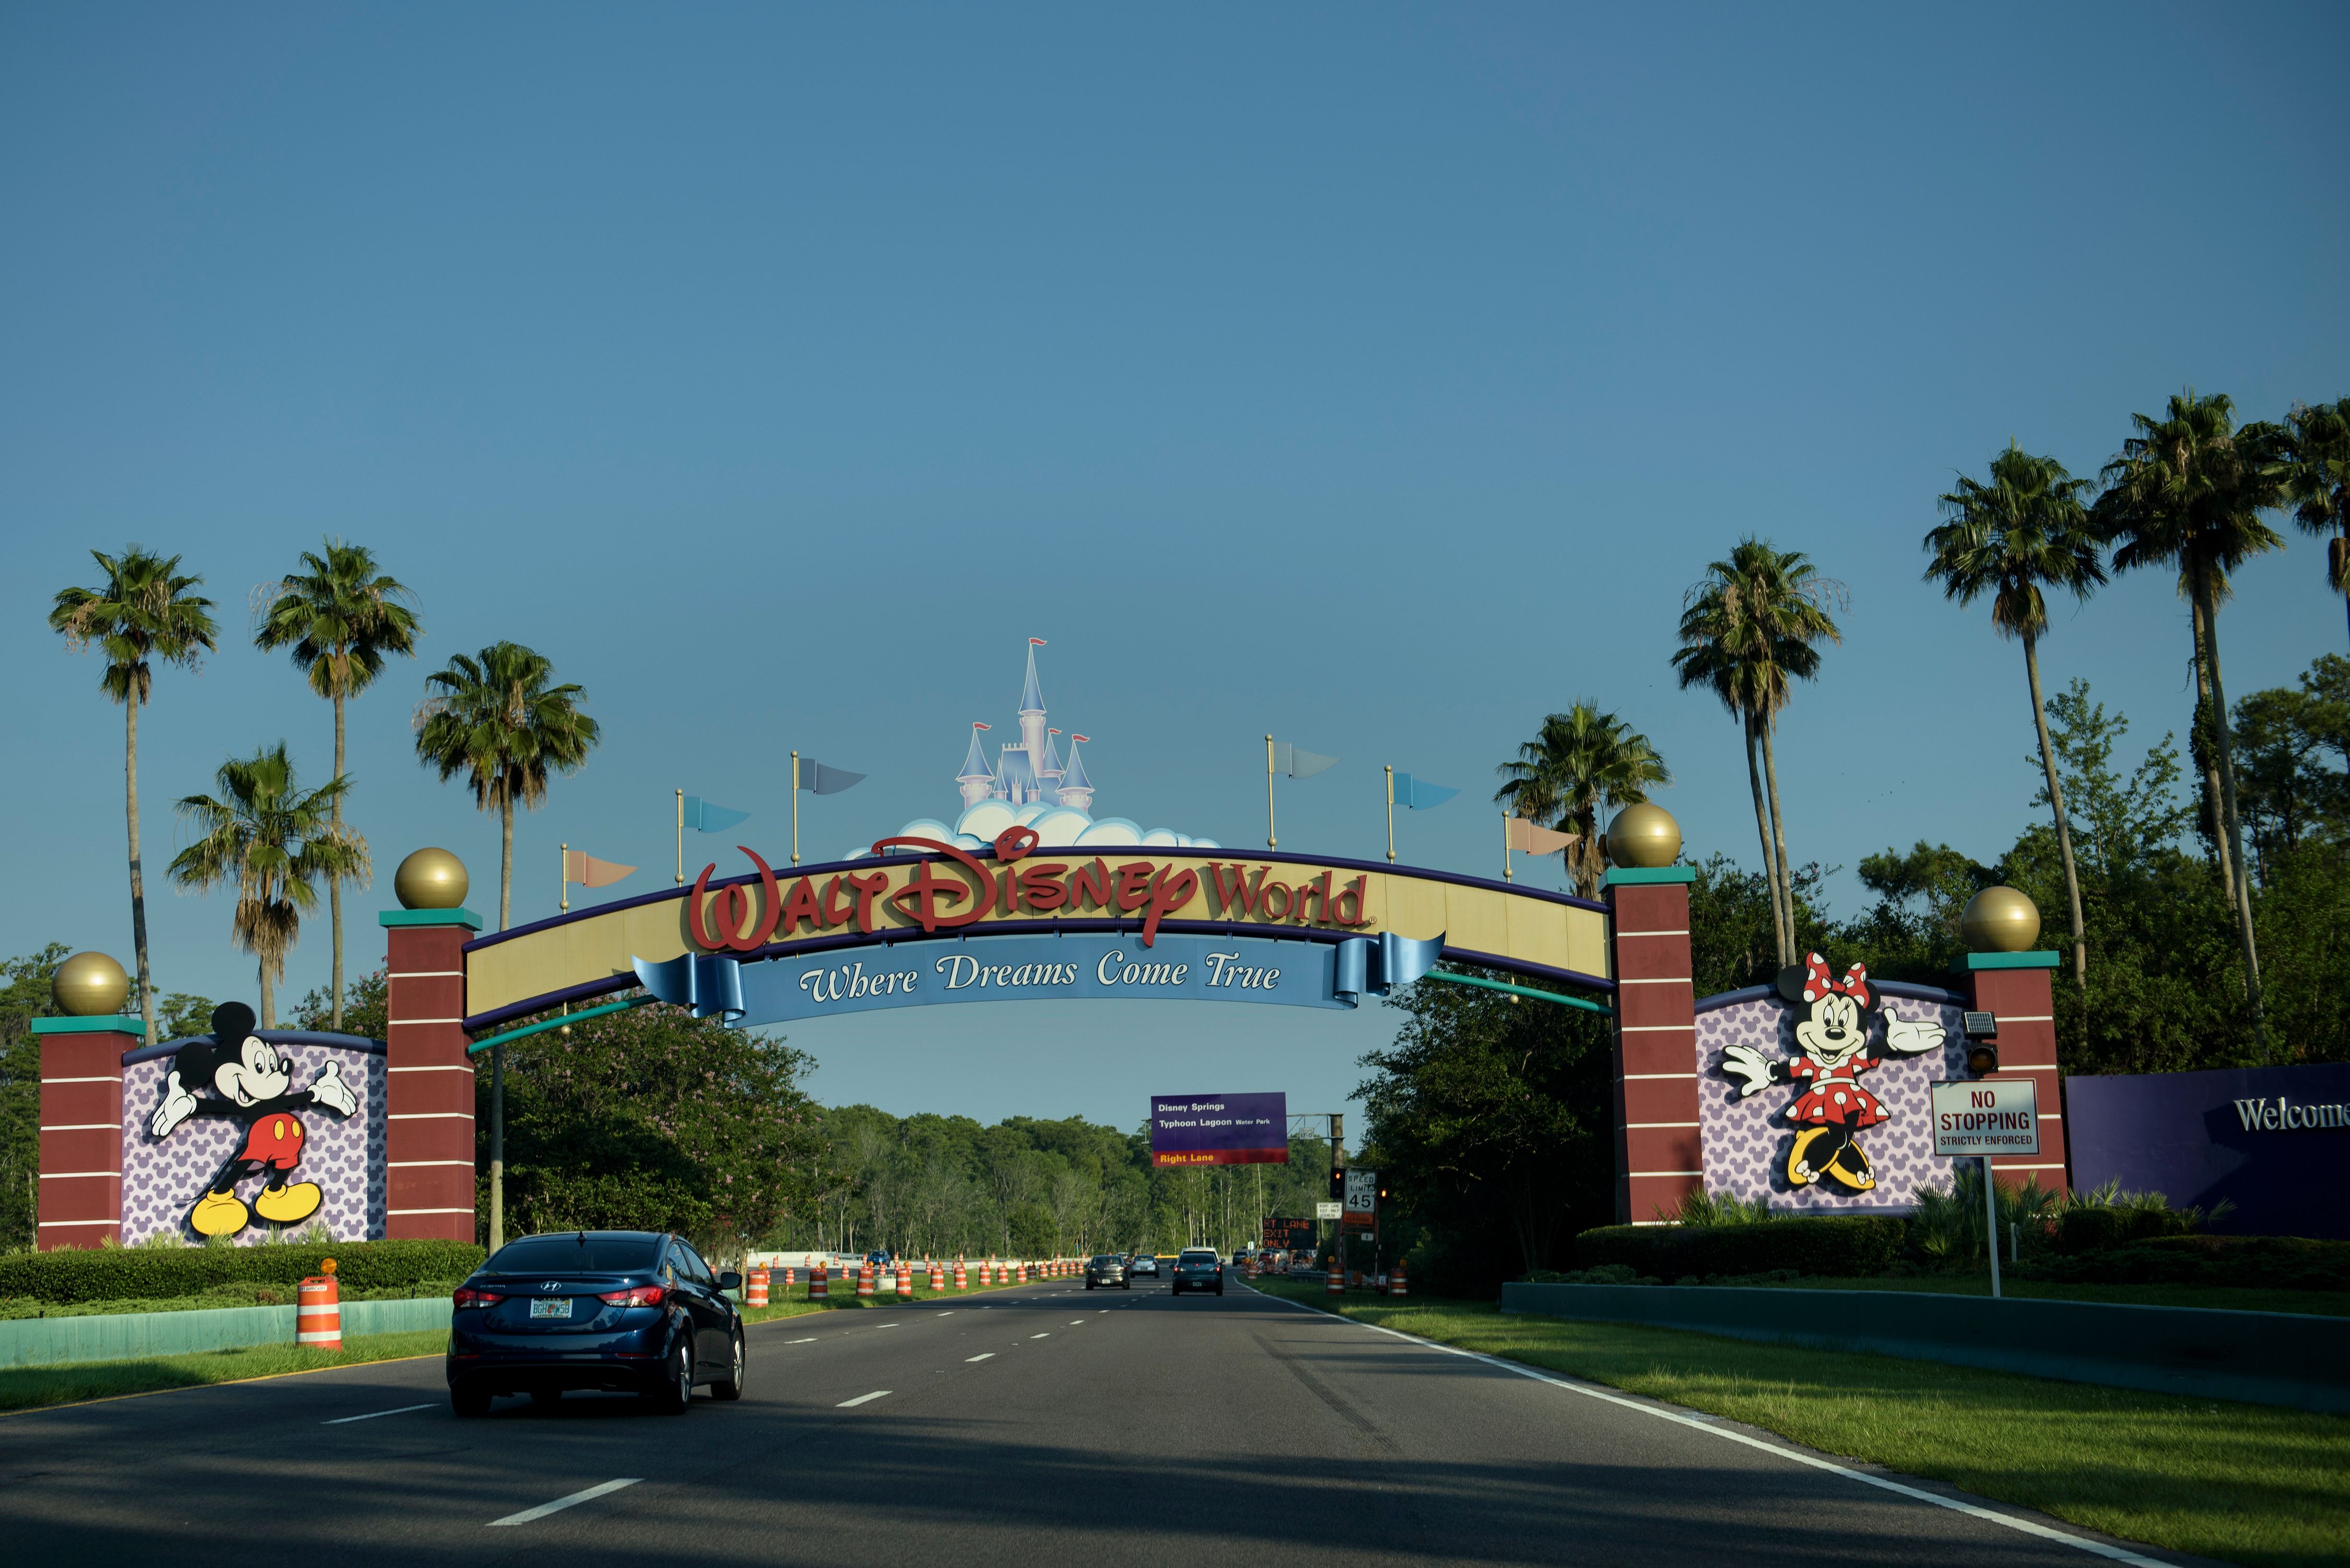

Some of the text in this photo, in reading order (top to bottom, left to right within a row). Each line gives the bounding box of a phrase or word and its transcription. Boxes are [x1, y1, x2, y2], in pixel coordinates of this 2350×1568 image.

[800, 949, 1281, 1003] Where Dreams Come True
[1971, 1091, 1995, 1108] NO
[1192, 1103, 1225, 1112] Springs
[1159, 1120, 1196, 1128] Typhoon
[1200, 1119, 1232, 1127] Lagoon
[1941, 1112, 2029, 1130] STOPPING
[1941, 1135, 2032, 1146] STRICTLY ENFORCED
[1160, 1154, 1186, 1163] Right
[1349, 1194, 1371, 1208] 45
[1264, 1220, 1309, 1229] RT LANE
[1264, 1229, 1289, 1237] EXIT
[1264, 1240, 1289, 1248] ONLY
